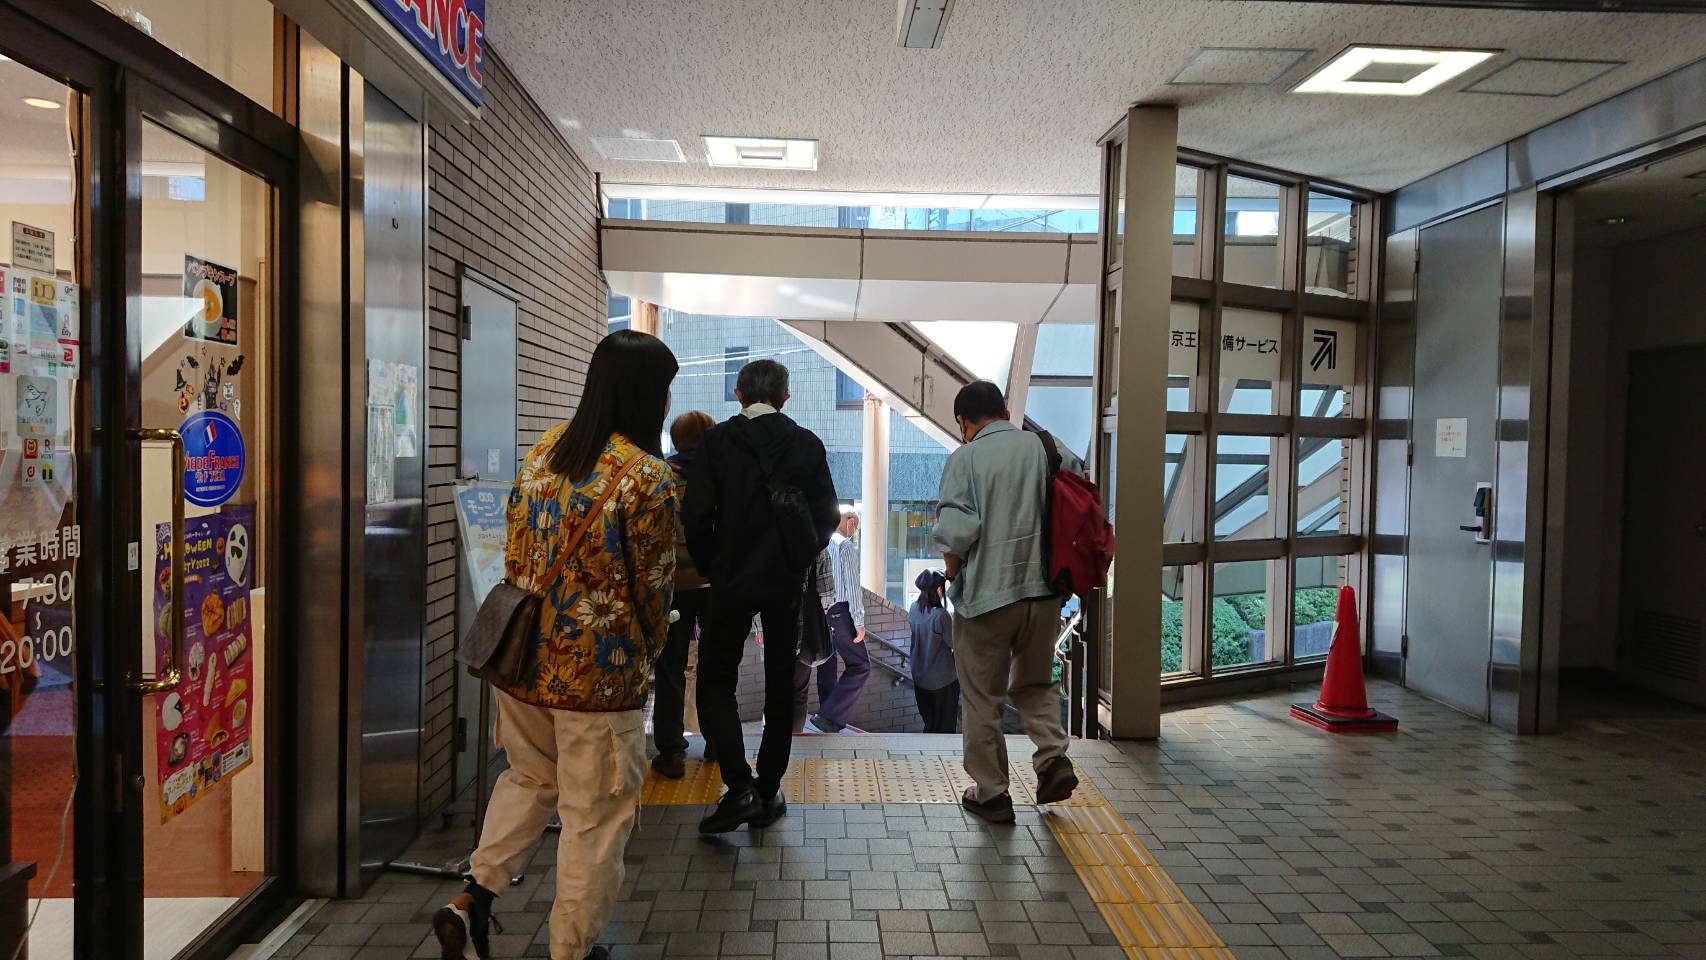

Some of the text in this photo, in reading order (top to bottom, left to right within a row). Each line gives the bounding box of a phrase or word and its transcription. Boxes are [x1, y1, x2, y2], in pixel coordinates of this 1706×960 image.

[34, 281, 56, 301] iD
[1171, 330, 1278, 354] 京王備サービス
[207, 449, 240, 470] FRANCE
[18, 570, 72, 610] 7:30
[0, 626, 73, 674] 20:00
